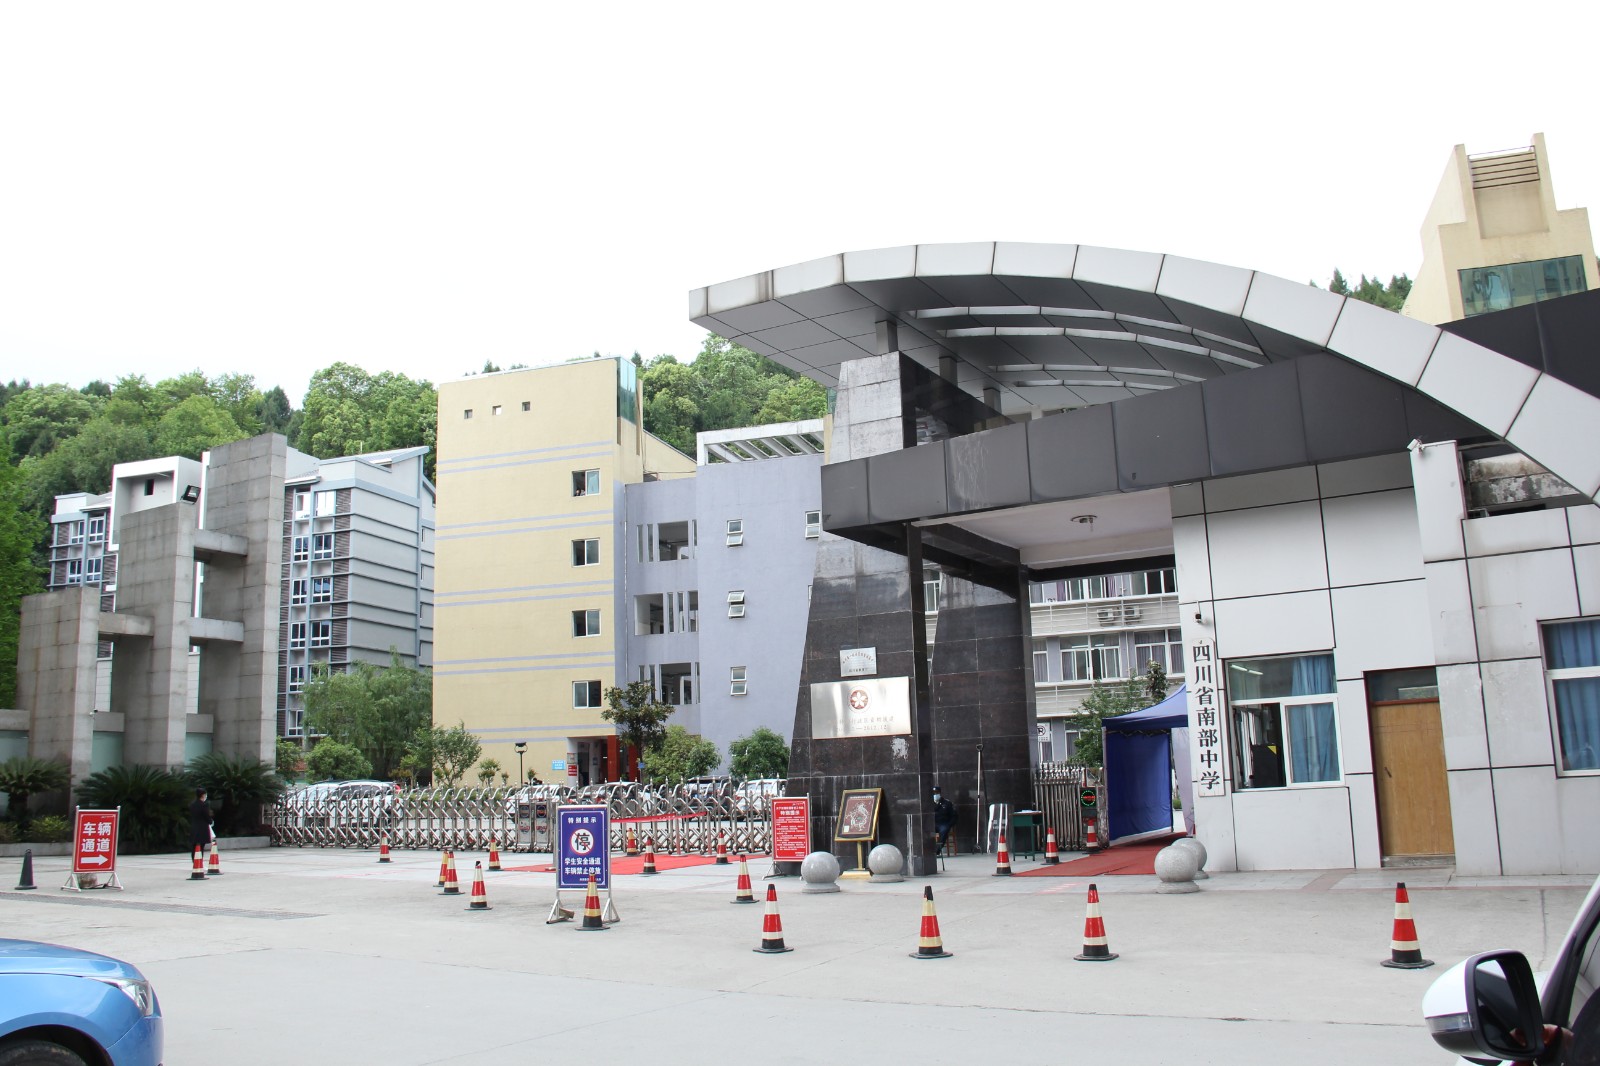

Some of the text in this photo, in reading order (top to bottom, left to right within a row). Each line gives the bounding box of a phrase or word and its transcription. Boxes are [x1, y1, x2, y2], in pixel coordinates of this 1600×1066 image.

[1192, 644, 1220, 790] 四川省南部中学
[567, 816, 597, 824] 特别提示
[82, 821, 112, 836] 车辆
[81, 837, 111, 853] 通道
[564, 857, 602, 866] 学生安全通道
[564, 866, 602, 875] 车辆禁止停放
